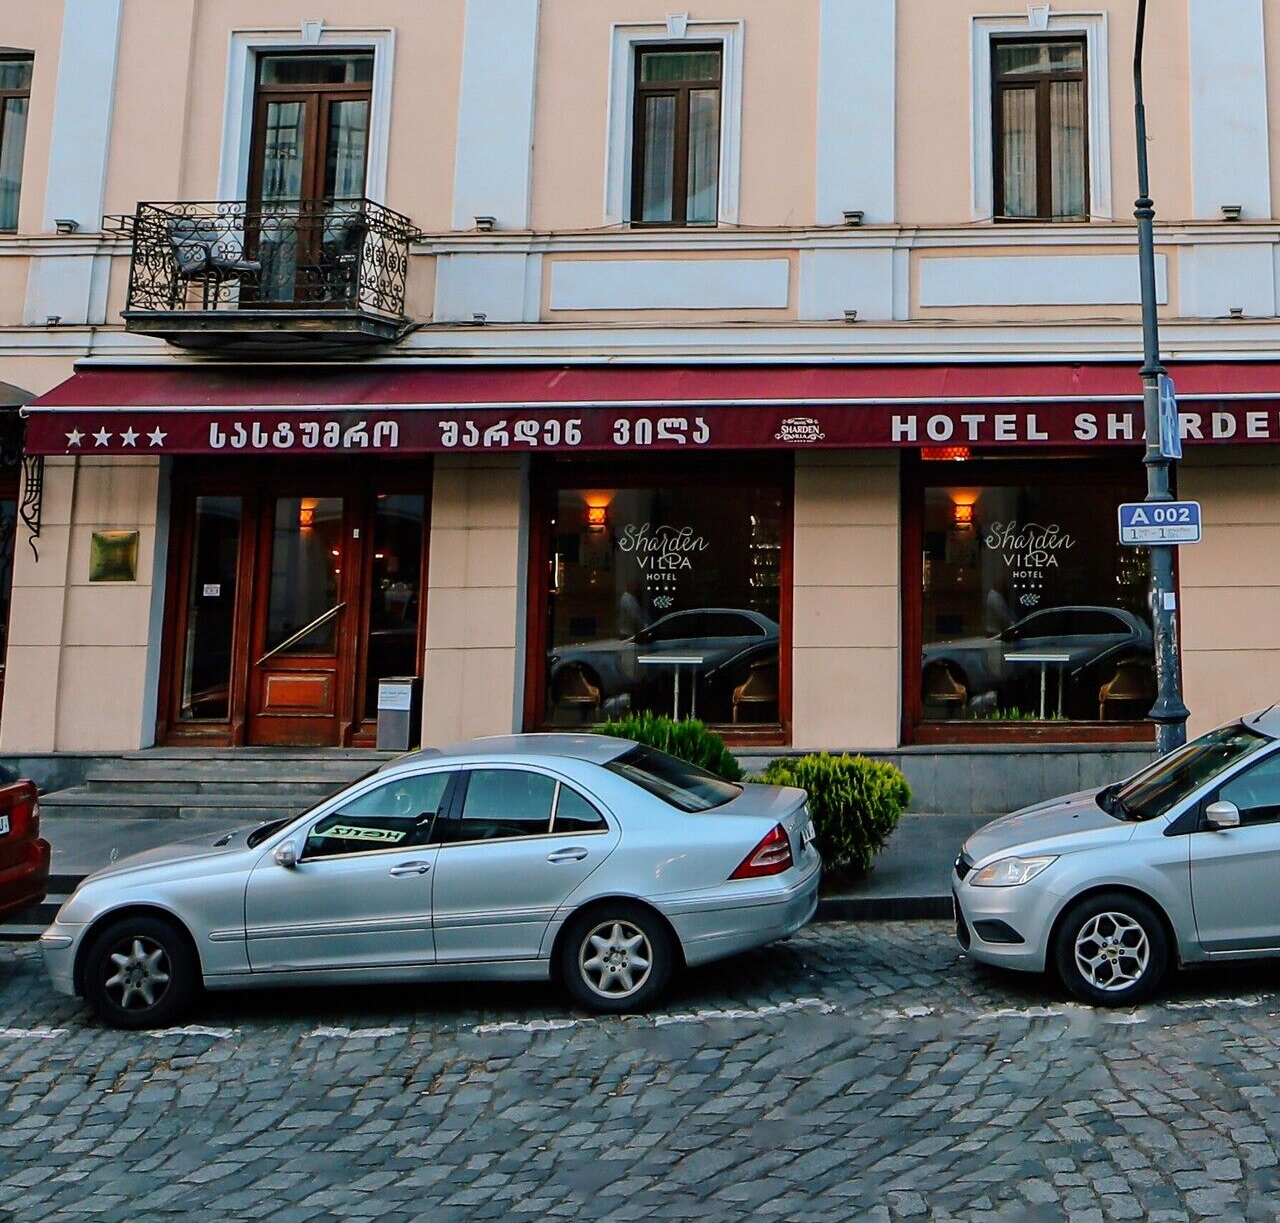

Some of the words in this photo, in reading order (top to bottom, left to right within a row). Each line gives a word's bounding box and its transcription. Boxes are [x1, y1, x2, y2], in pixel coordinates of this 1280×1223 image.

[208, 420, 399, 449] სასტუმრო
[438, 417, 582, 447] შარდენ
[613, 416, 710, 446] ვილა
[891, 413, 1049, 442] HOTEL
[1131, 509, 1149, 524] A
[1155, 508, 1190, 522] 002
[618, 523, 709, 558] Sharden
[985, 521, 1076, 556] Sharden
[636, 556, 692, 569] VILLA
[1003, 554, 1059, 567] VILLA
